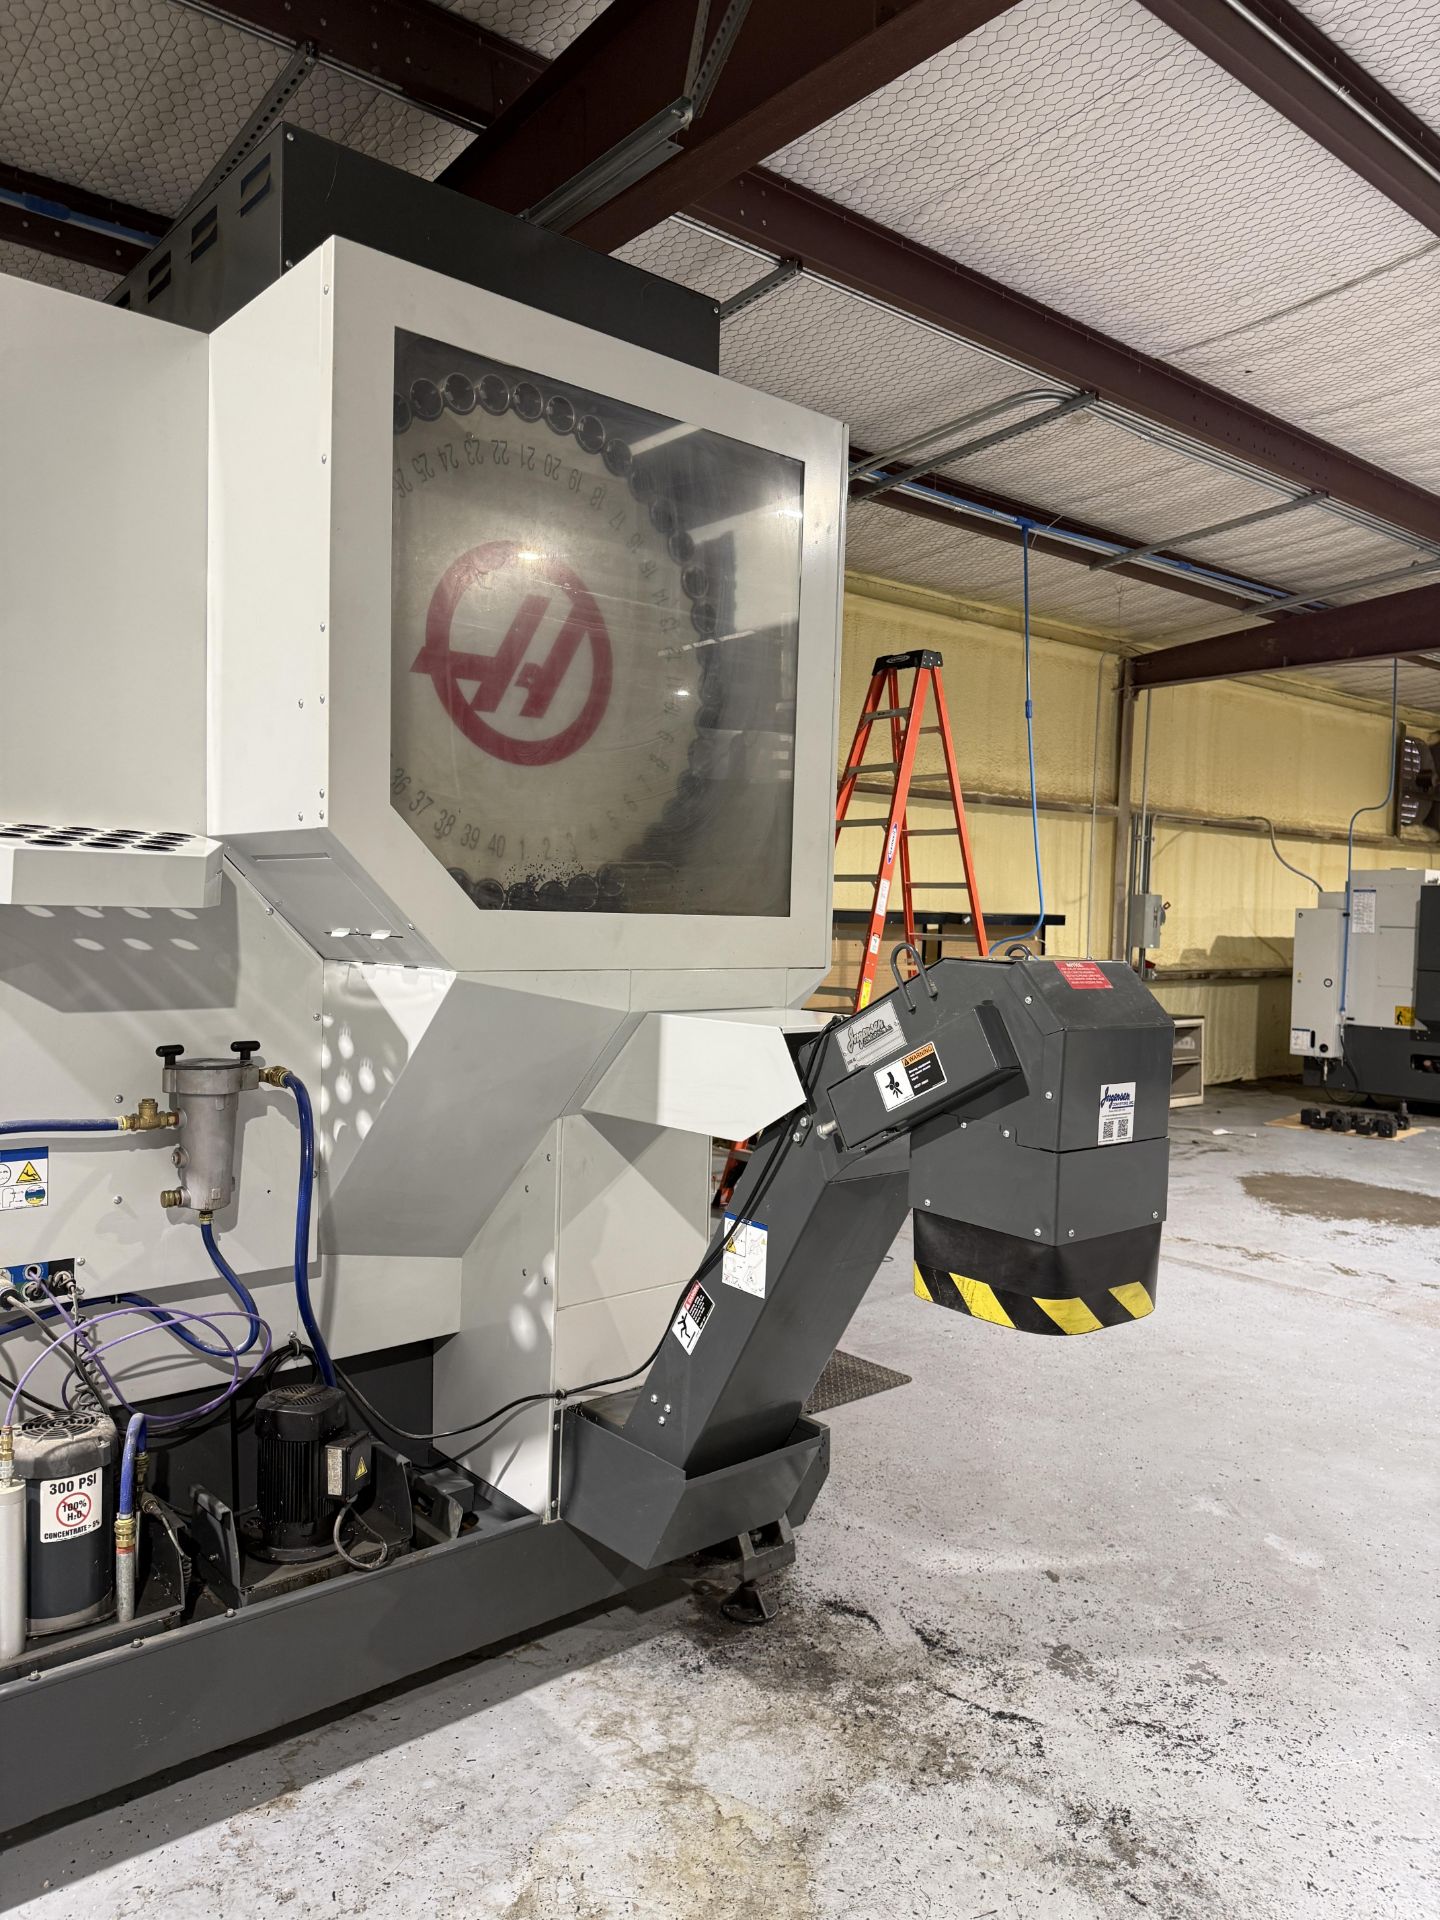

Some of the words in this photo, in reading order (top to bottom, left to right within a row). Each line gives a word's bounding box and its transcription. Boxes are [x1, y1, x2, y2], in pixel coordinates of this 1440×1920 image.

[437, 442, 459, 472] 24
[464, 439, 484, 465] 23
[491, 439, 510, 465] 22
[520, 443, 536, 471] 21
[411, 452, 435, 483] 25
[543, 453, 562, 480] 20
[567, 468, 583, 494] 19
[392, 768, 411, 795] 36
[408, 789, 435, 816] 37
[433, 808, 457, 839] 38
[460, 823, 481, 851] 39
[487, 833, 506, 859] 40
[542, 837, 552, 862] 2
[519, 839, 525, 862] 1
[909, 1045, 933, 1063] WARNING
[49, 1480, 75, 1496] 300
[78, 1472, 97, 1490] PSI
[62, 1498, 87, 1513] 100%
[44, 1524, 87, 1540] CONCENTRATE
